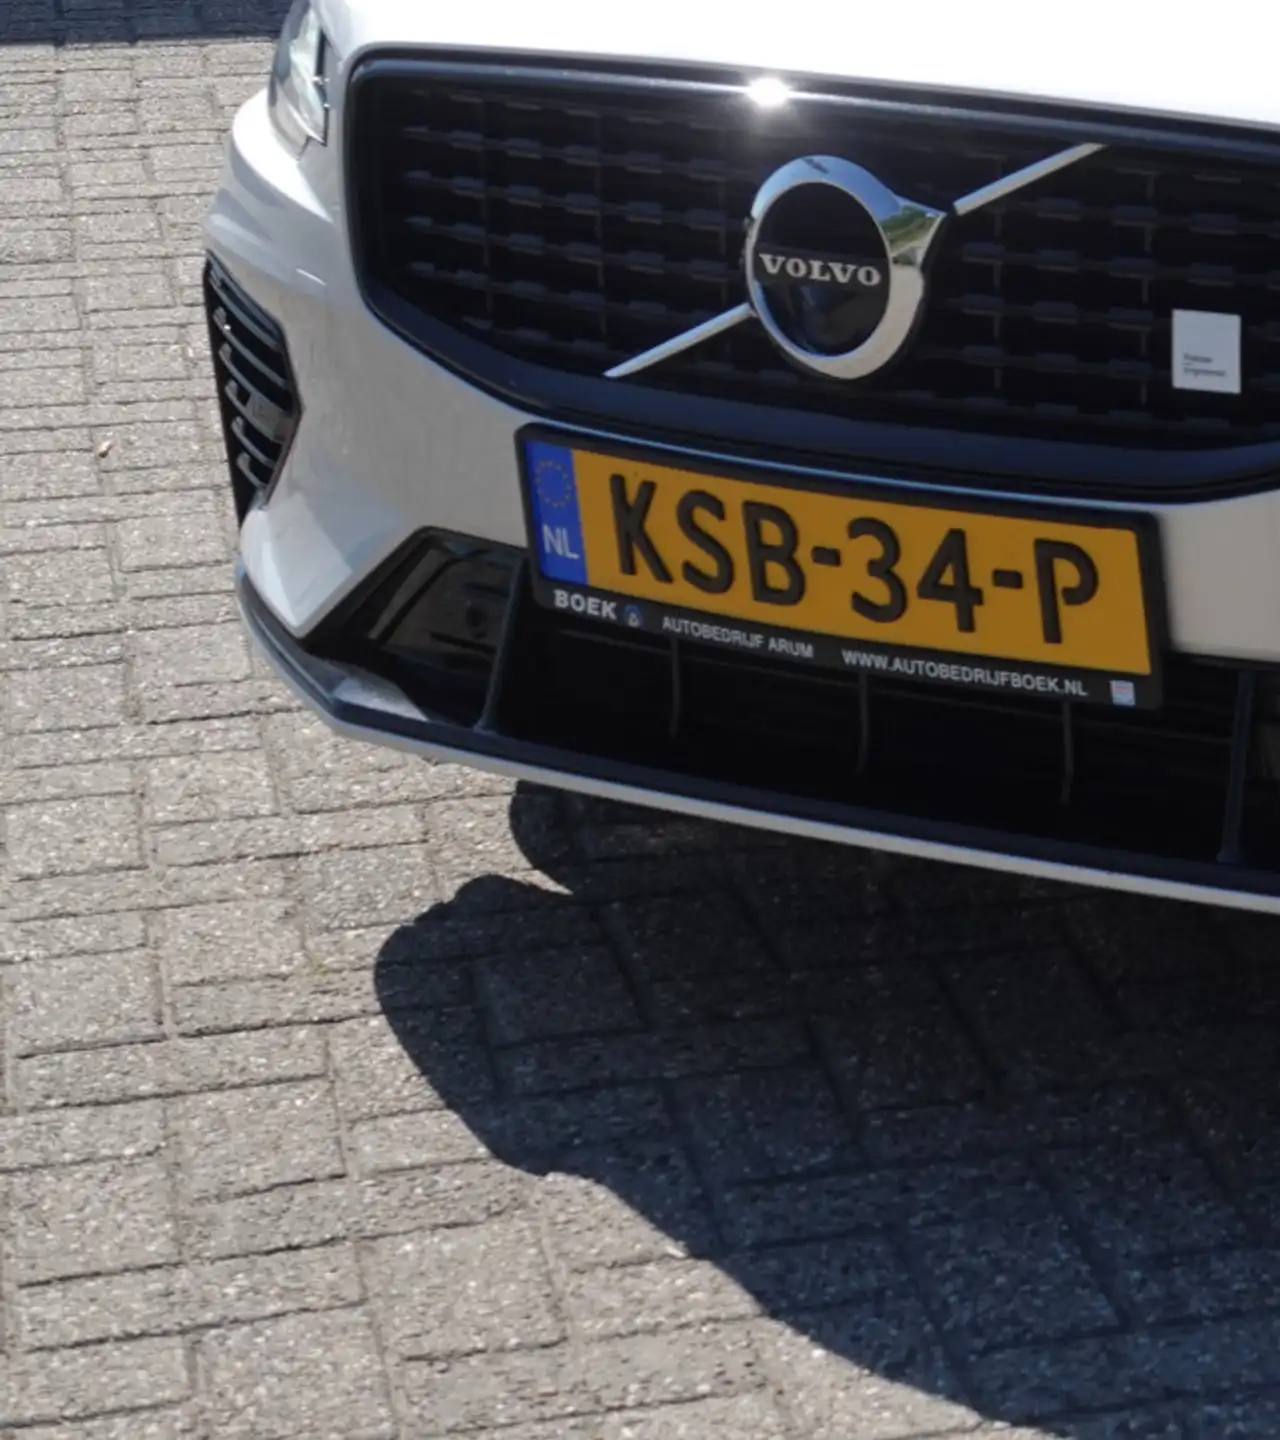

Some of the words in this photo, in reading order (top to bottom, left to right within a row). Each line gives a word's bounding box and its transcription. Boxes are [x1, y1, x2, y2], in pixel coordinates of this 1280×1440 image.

[758, 253, 881, 286] VOLVO
[542, 523, 581, 559] NL
[609, 471, 1099, 644] KSB-34-P
[553, 589, 618, 620] BOEK
[662, 616, 765, 648] AUTOBEDRIJF
[767, 638, 814, 658] ARUM
[841, 649, 1089, 696] WWW.AUTOBEDRIJFBOEK.NL
